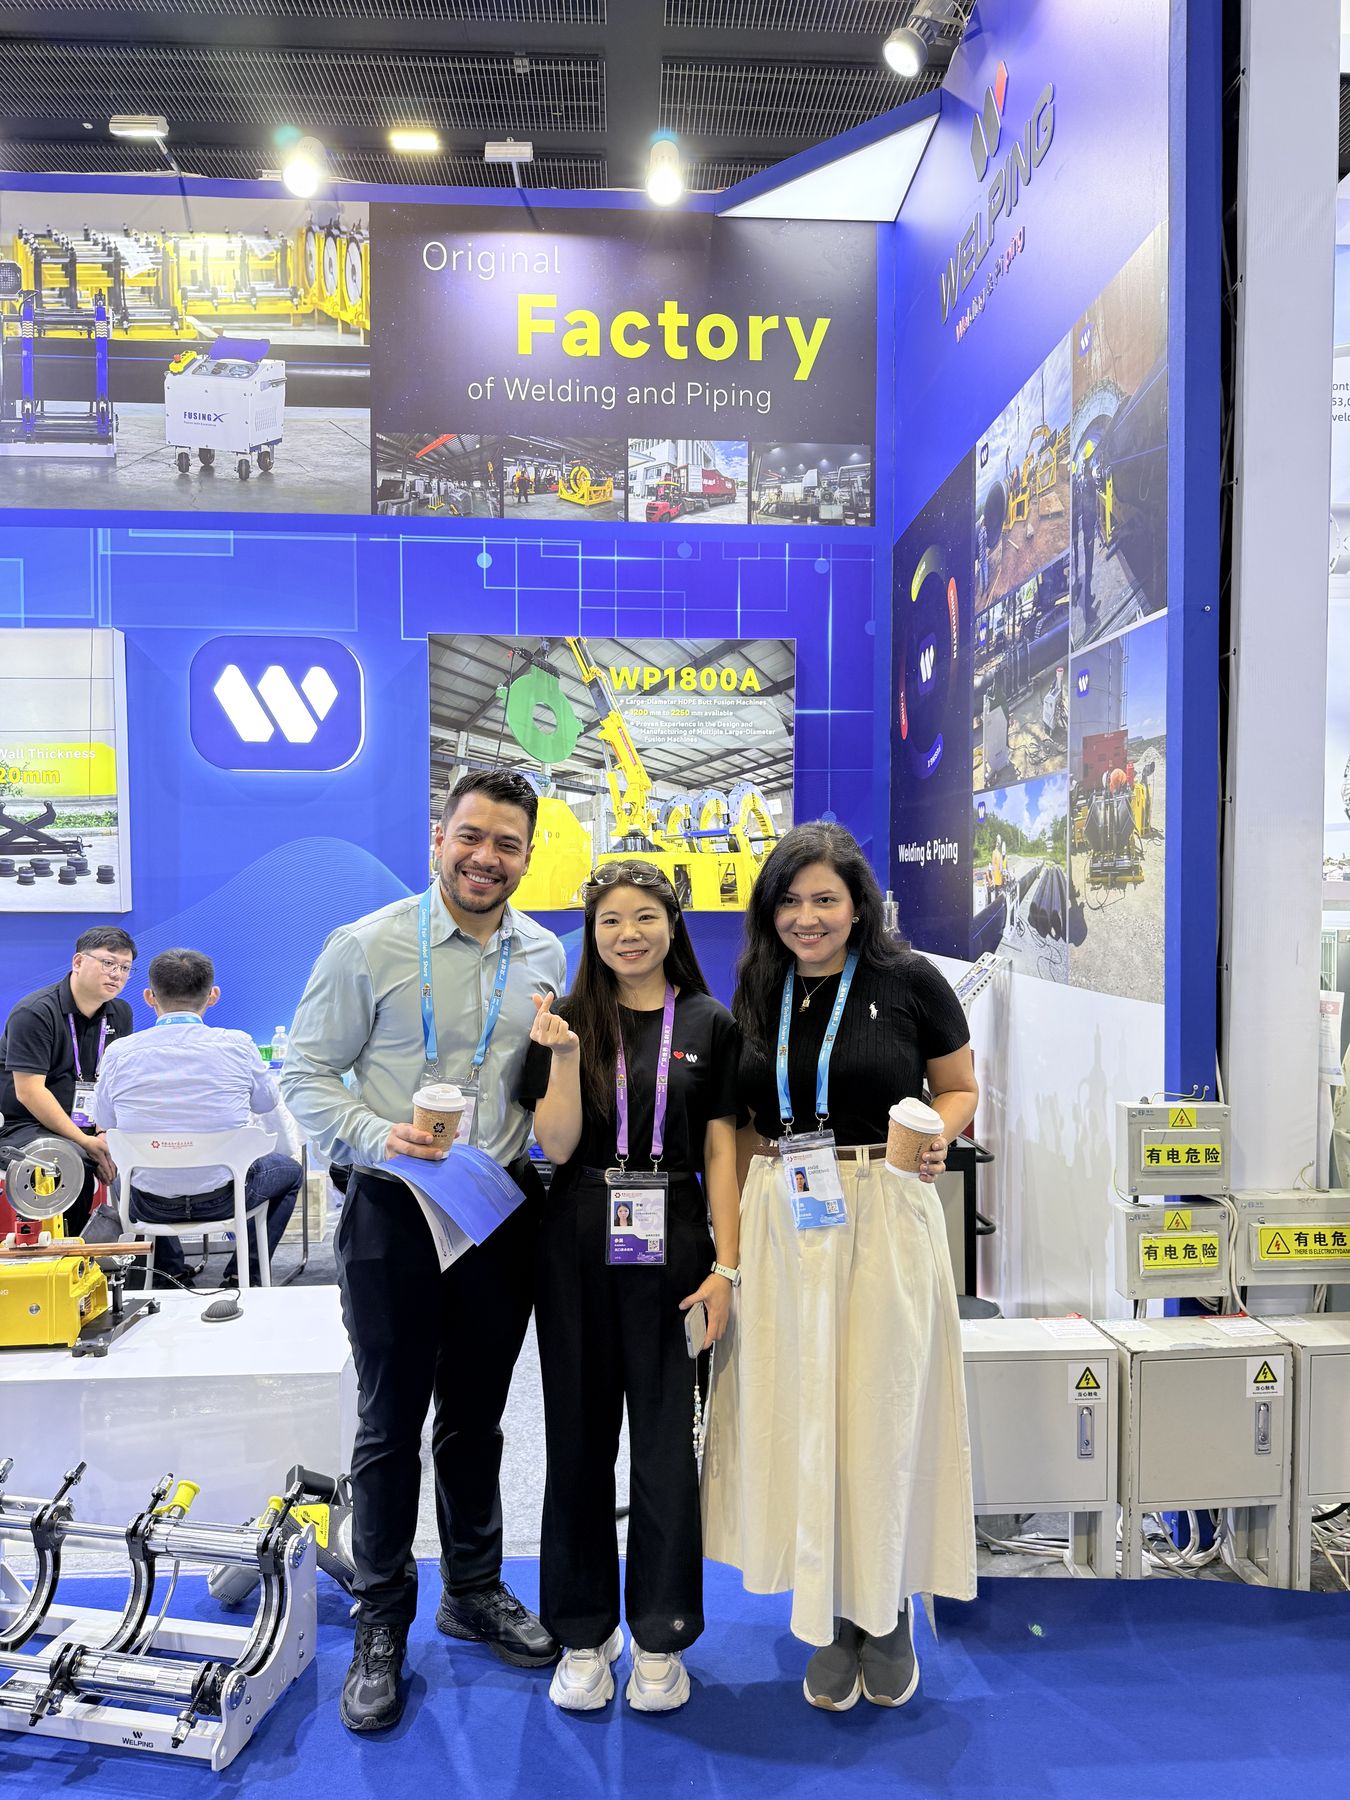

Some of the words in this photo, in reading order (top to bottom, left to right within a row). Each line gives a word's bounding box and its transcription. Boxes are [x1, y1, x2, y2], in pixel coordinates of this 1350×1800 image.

[940, 82, 1055, 325] WELPING
[422, 241, 561, 280] Original
[517, 293, 831, 381] Factory
[467, 377, 495, 401] of
[504, 377, 616, 413] Welding
[627, 382, 676, 406] and
[686, 382, 772, 414] Piping
[609, 666, 761, 692] WP1800A
[641, 729, 688, 737] Manufacturing
[660, 721, 697, 729] Experience
[717, 721, 740, 729] Design
[28, 749, 96, 760] Thickness
[898, 841, 926, 867] Welding
[926, 840, 932, 861] &
[933, 837, 959, 866] Piping
[1146, 1147, 1220, 1164] 有电危险
[1294, 1231, 1348, 1247] 有电危
[1144, 1243, 1218, 1261] 有电危险
[121, 1736, 154, 1748] WELPING
